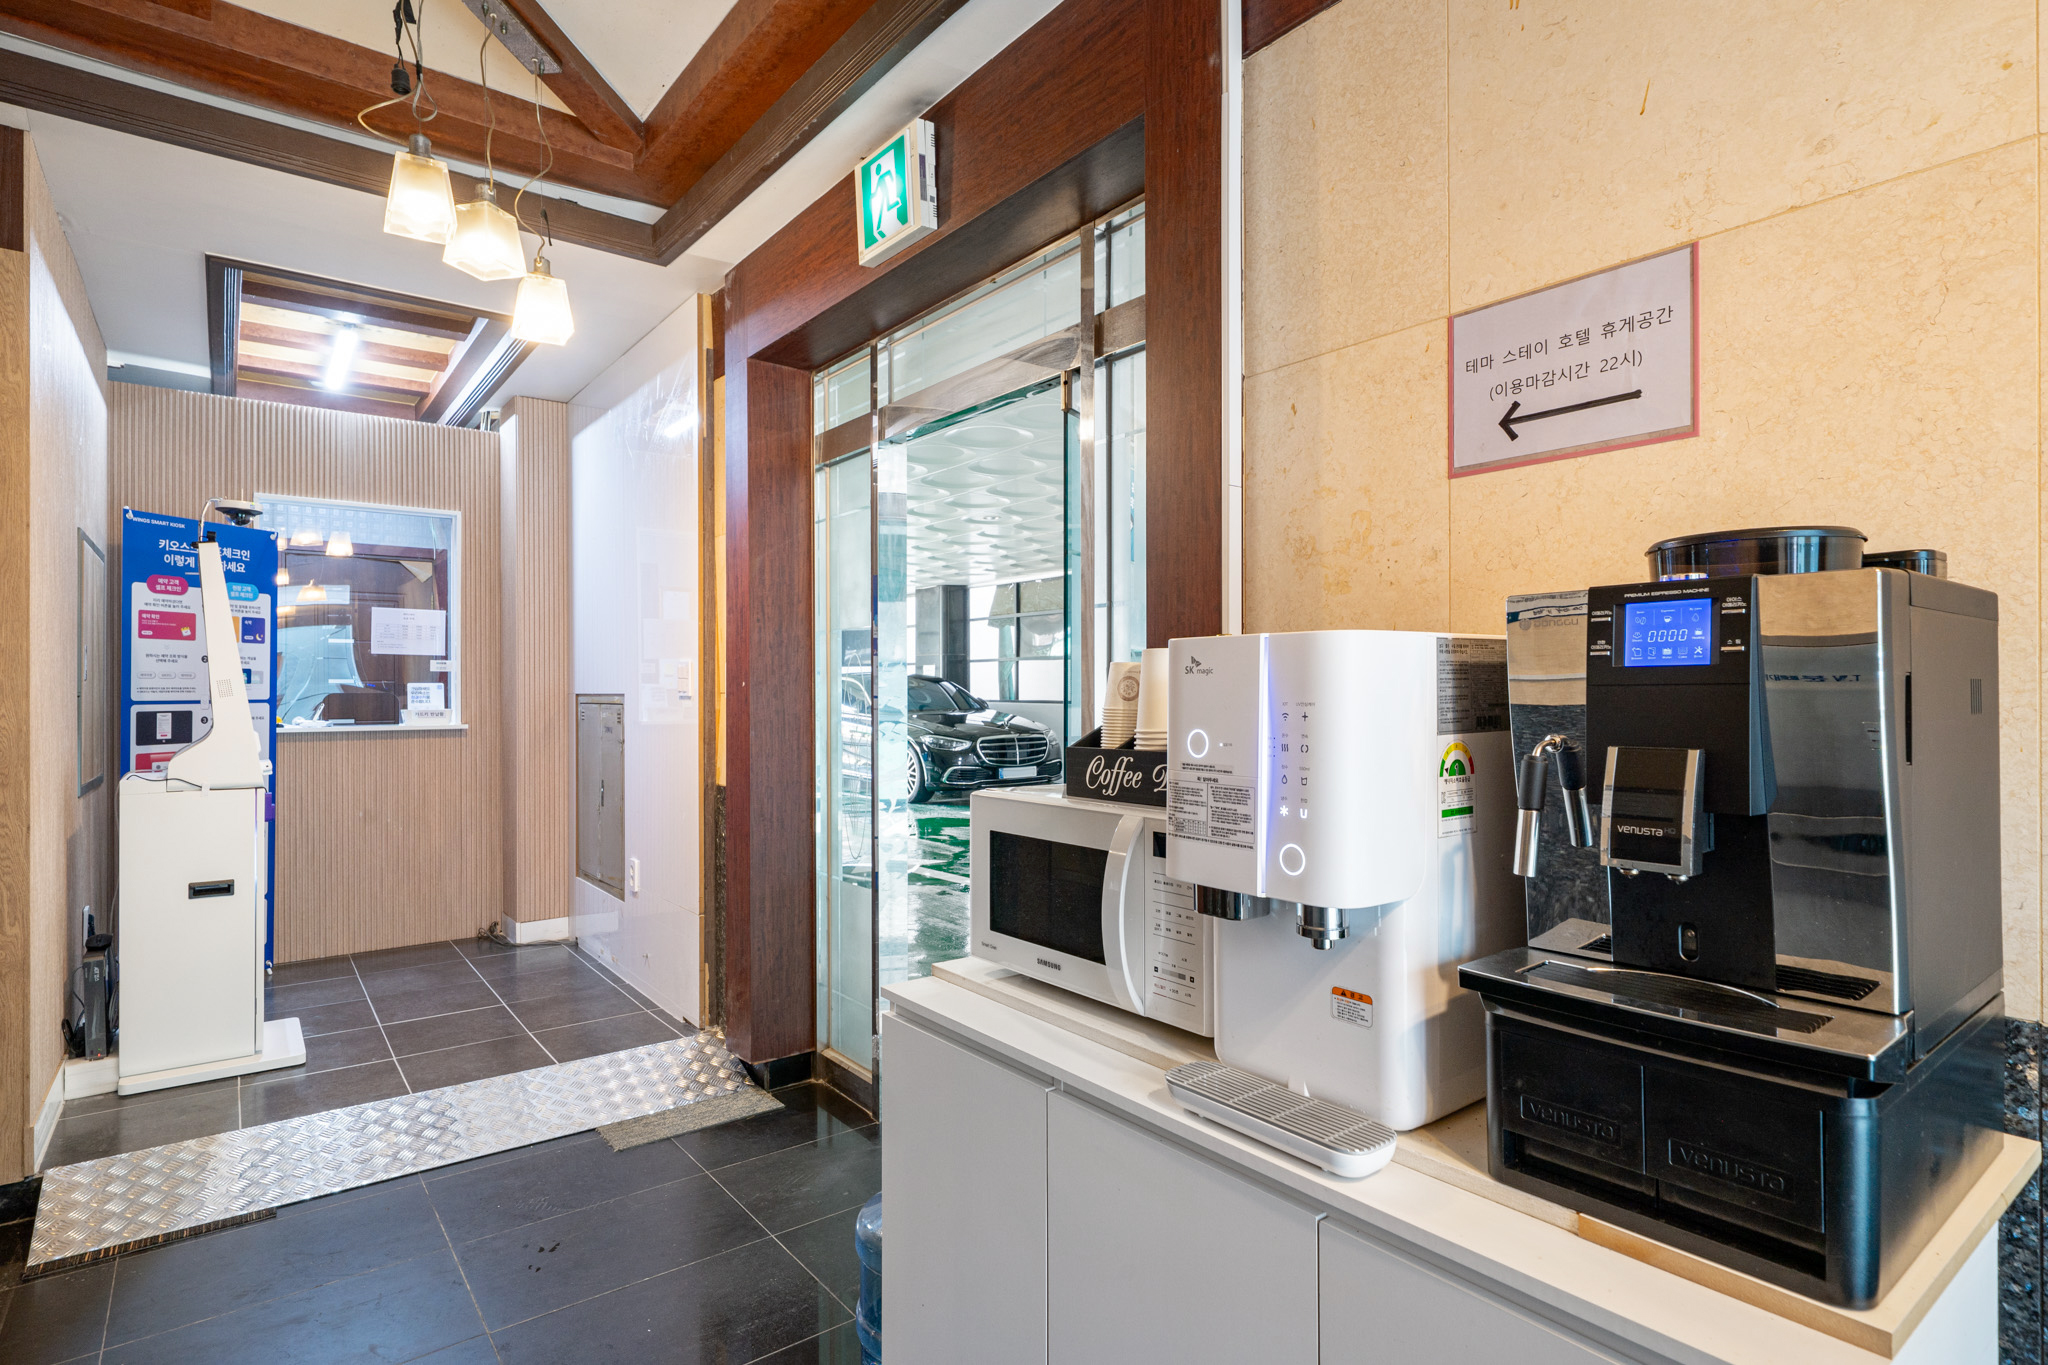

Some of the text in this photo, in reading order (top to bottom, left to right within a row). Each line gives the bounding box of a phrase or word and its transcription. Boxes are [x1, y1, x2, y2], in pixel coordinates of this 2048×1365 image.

[1465, 305, 1674, 374] 테마 스테이 호텔 휴게공간
[1489, 349, 1644, 401] (이용마감시간 22시)
[151, 518, 169, 526] SMART
[164, 554, 195, 568] 이렇게
[1647, 628, 1688, 643] 0000
[1185, 666, 1213, 676] SK magic
[1086, 754, 1142, 796] Coffee
[1036, 958, 1061, 971] SAMSUNG
